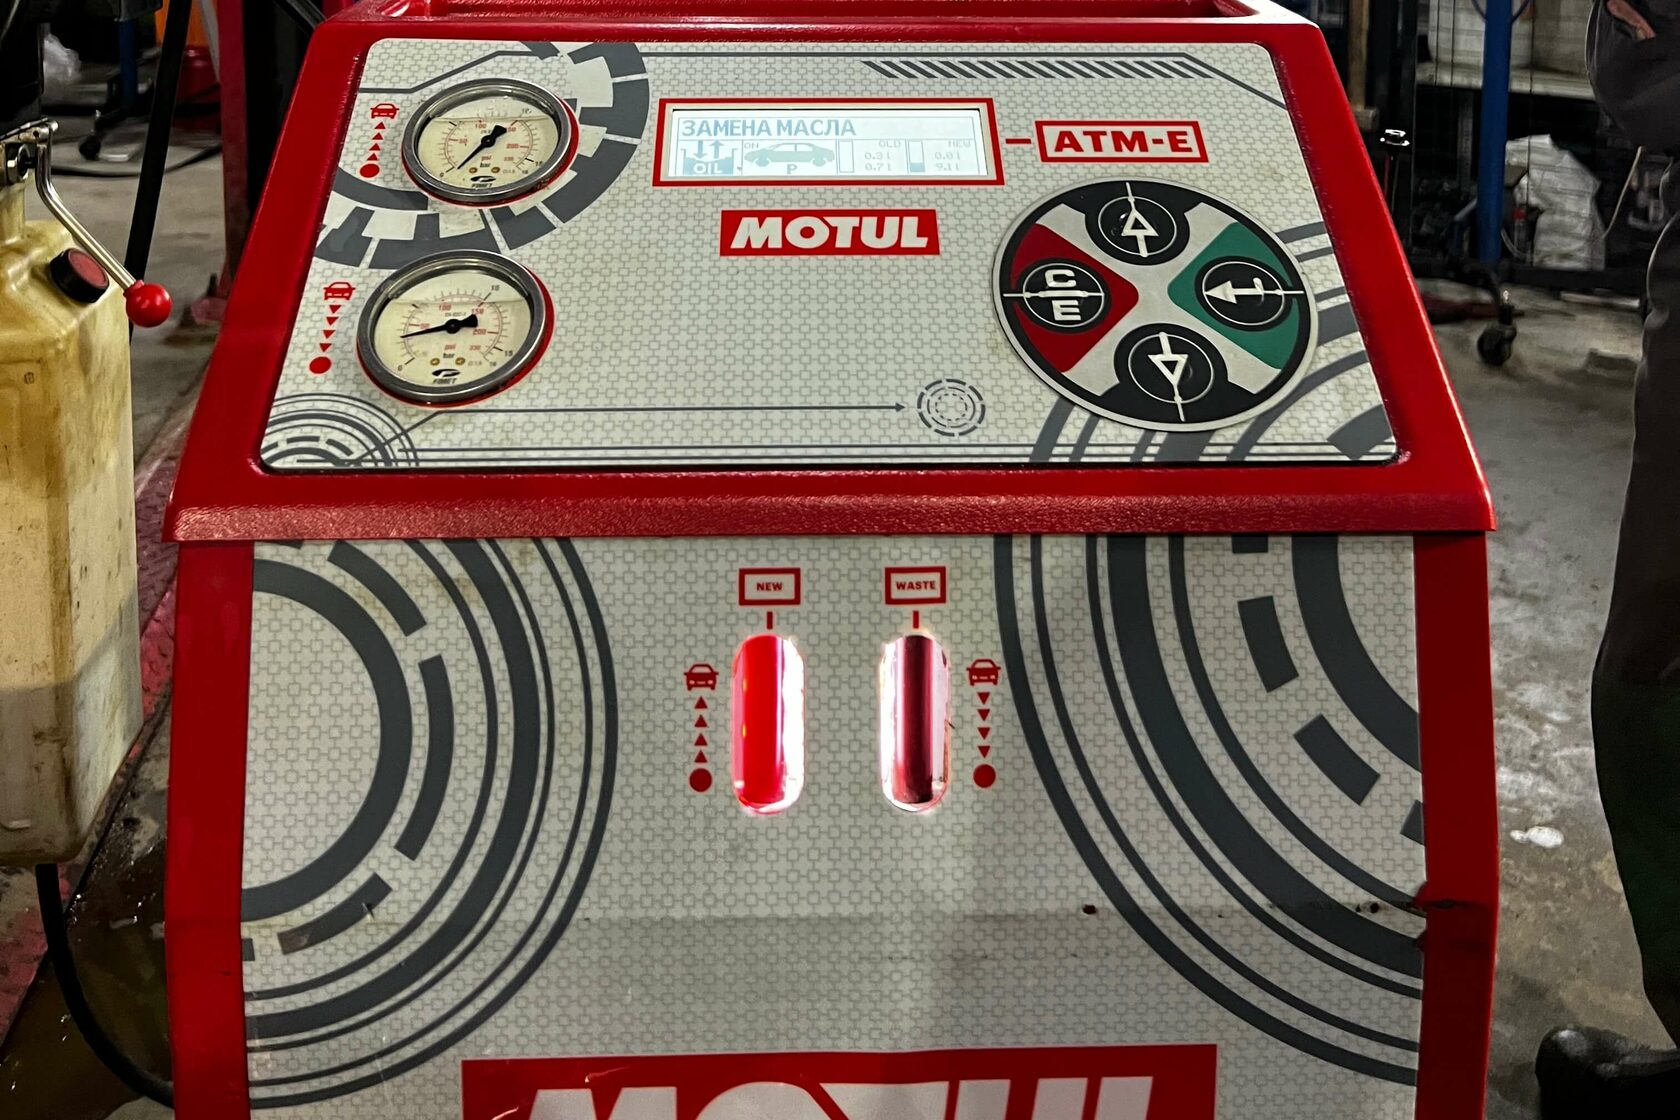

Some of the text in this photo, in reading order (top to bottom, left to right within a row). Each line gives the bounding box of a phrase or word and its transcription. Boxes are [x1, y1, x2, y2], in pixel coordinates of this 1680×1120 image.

[682, 119, 857, 137] ЗАМЕНА МАСЛА
[878, 140, 901, 148] OLD
[948, 140, 971, 148] NEW
[1054, 130, 1193, 153] ATM-E
[693, 163, 723, 174] OIL
[787, 164, 798, 174] P
[730, 216, 929, 249] MOTUL
[756, 582, 783, 592] NEW
[895, 580, 937, 591] WASTE
